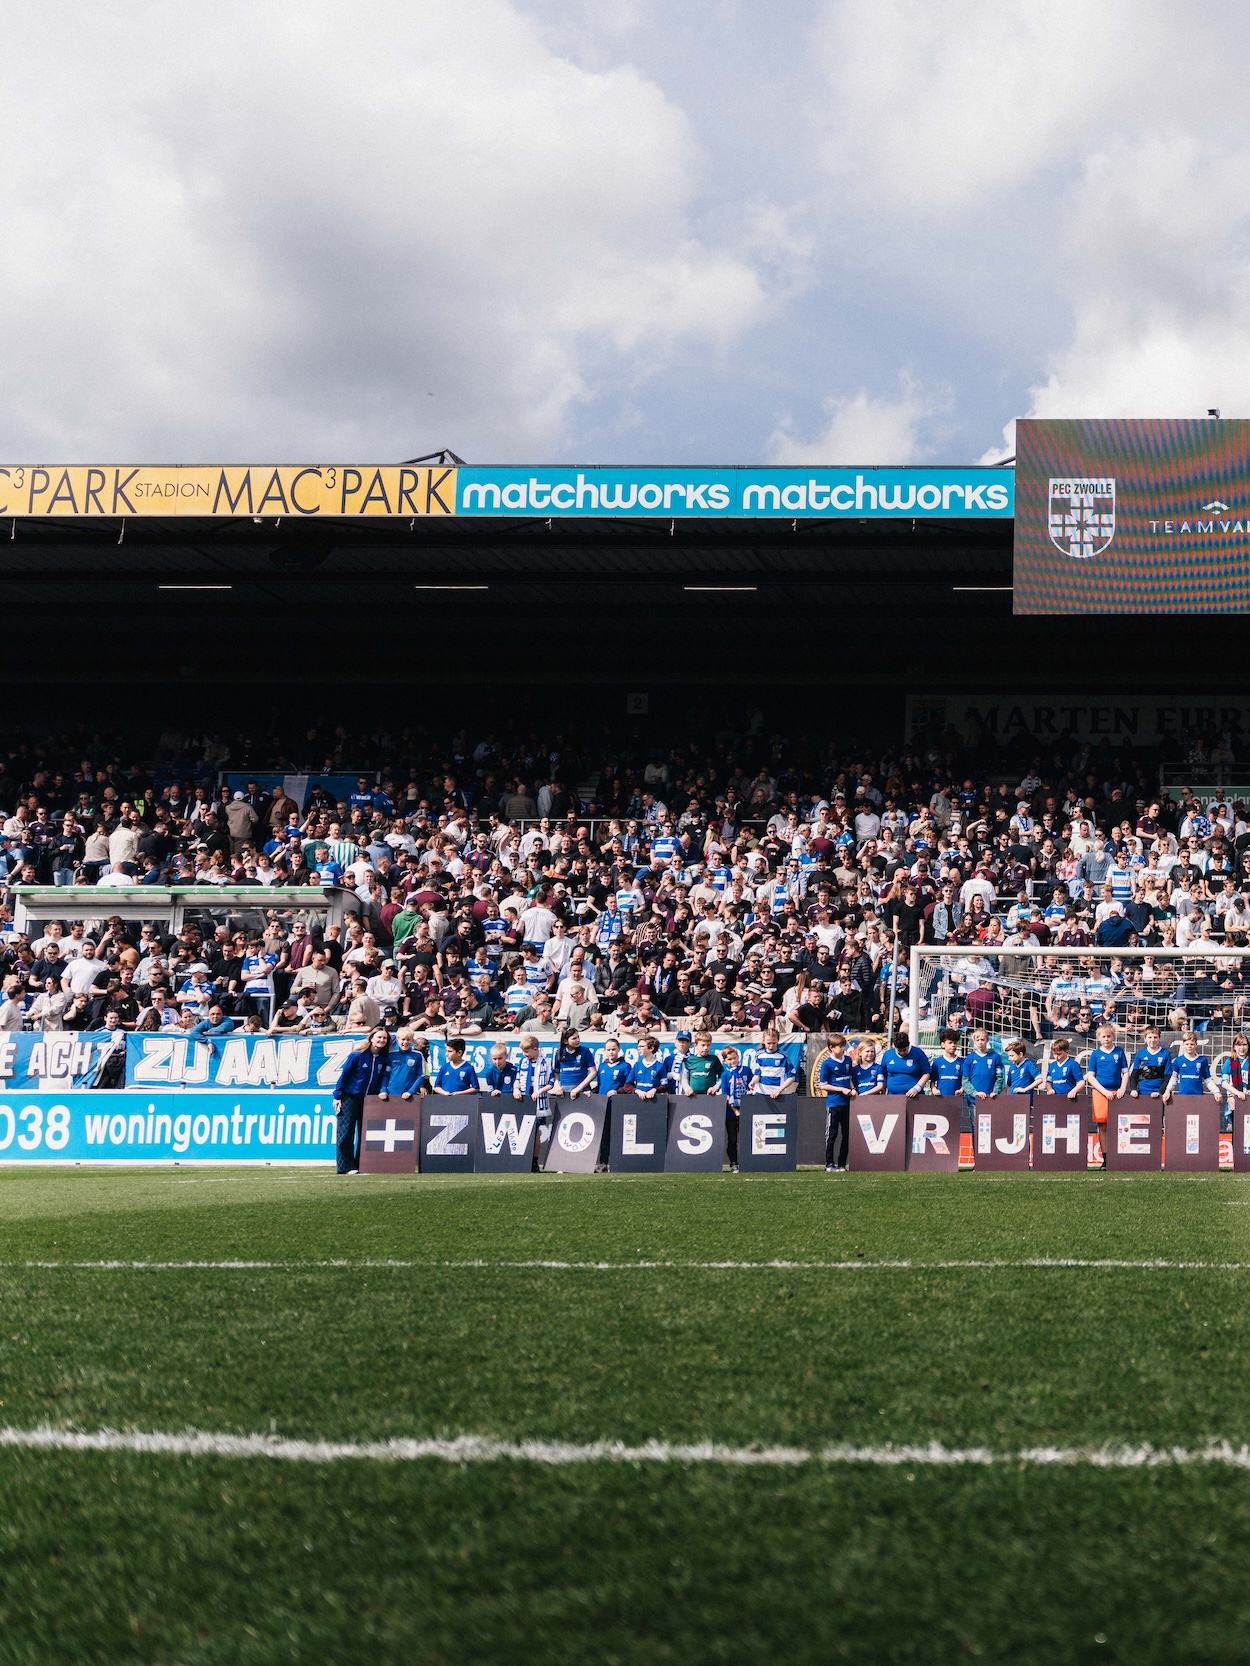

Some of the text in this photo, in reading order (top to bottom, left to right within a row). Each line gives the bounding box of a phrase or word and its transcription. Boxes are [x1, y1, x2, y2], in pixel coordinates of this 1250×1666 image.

[134, 482, 210, 498] STADION
[462, 473, 1009, 510] matchworks matchworks
[1052, 483, 1112, 494] PEC ZWOLLE
[633, 697, 643, 710] 2
[134, 1038, 211, 1083] ZIJ
[215, 1038, 312, 1086] AAN
[84, 1103, 338, 1153] woningontruimin
[426, 1113, 787, 1155] ZWOLSE
